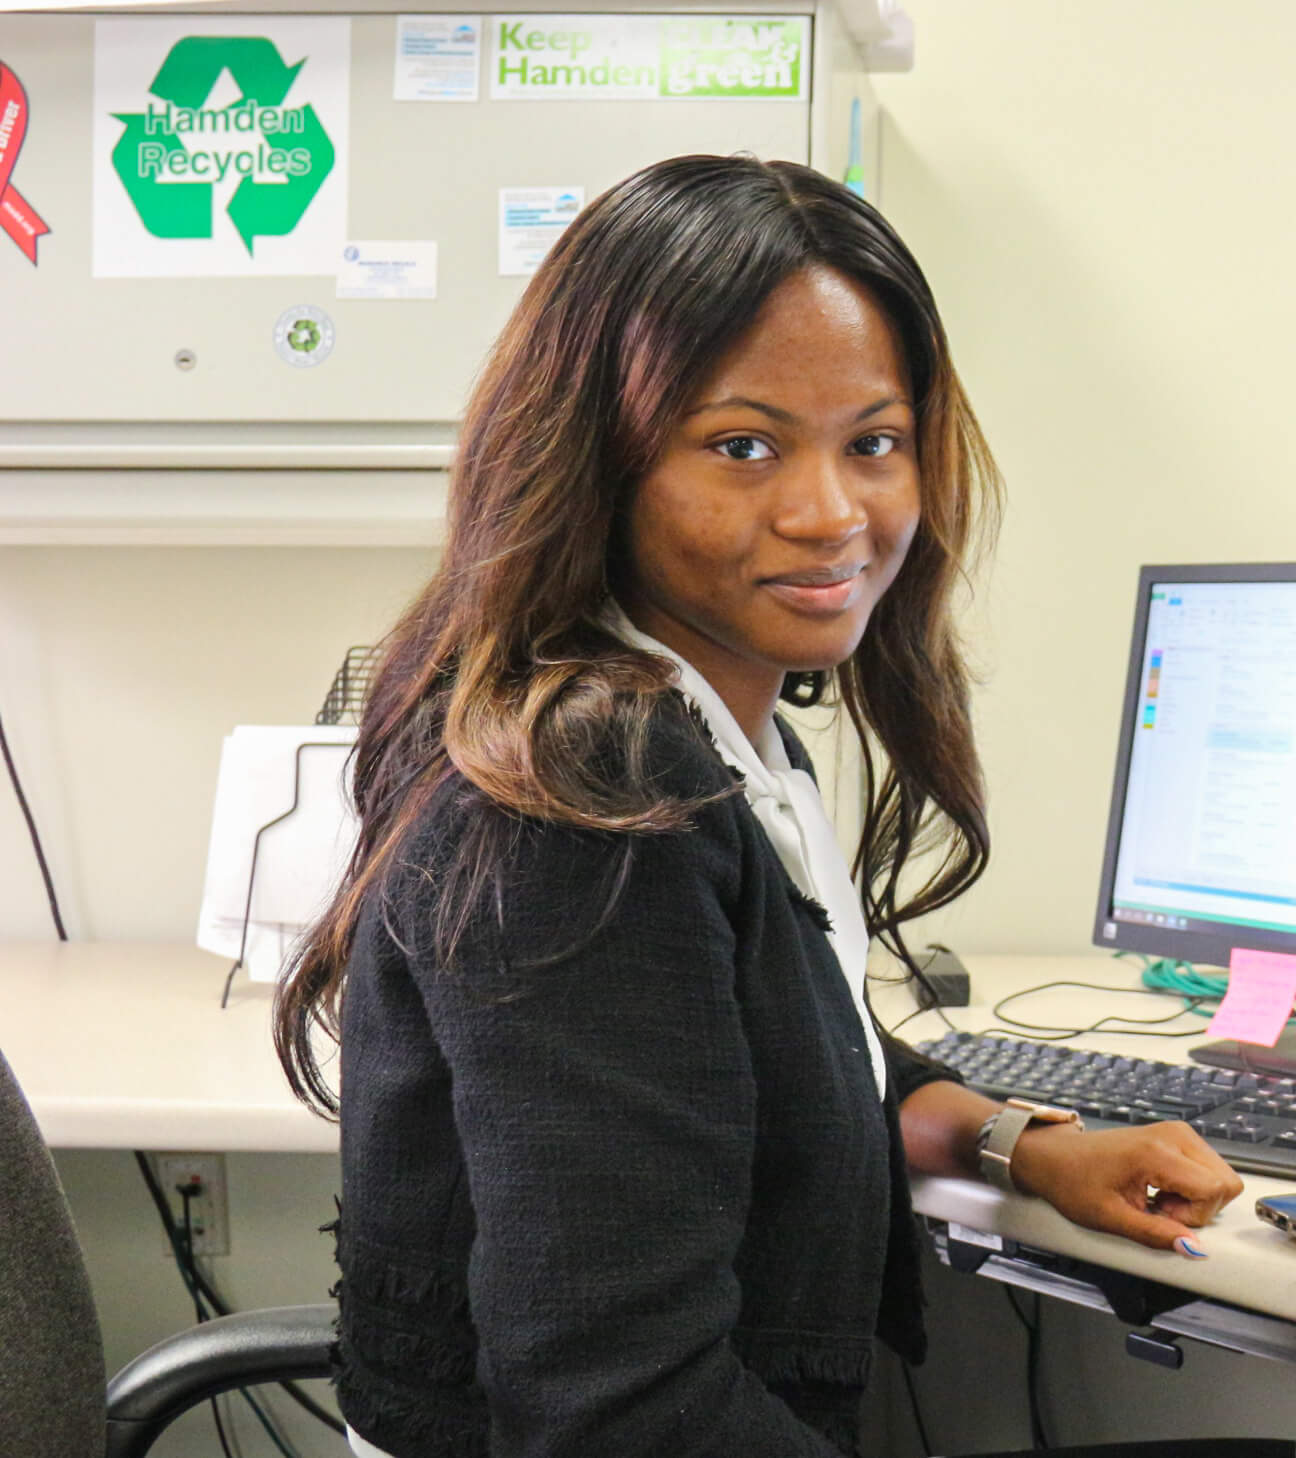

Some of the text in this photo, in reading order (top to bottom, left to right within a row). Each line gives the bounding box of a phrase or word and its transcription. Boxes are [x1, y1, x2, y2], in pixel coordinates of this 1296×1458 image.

[499, 22, 592, 60] Keep
[498, 56, 656, 86] Hamden
[669, 58, 792, 92] green
[144, 98, 305, 135] Hamden
[138, 142, 312, 183] Recycles
